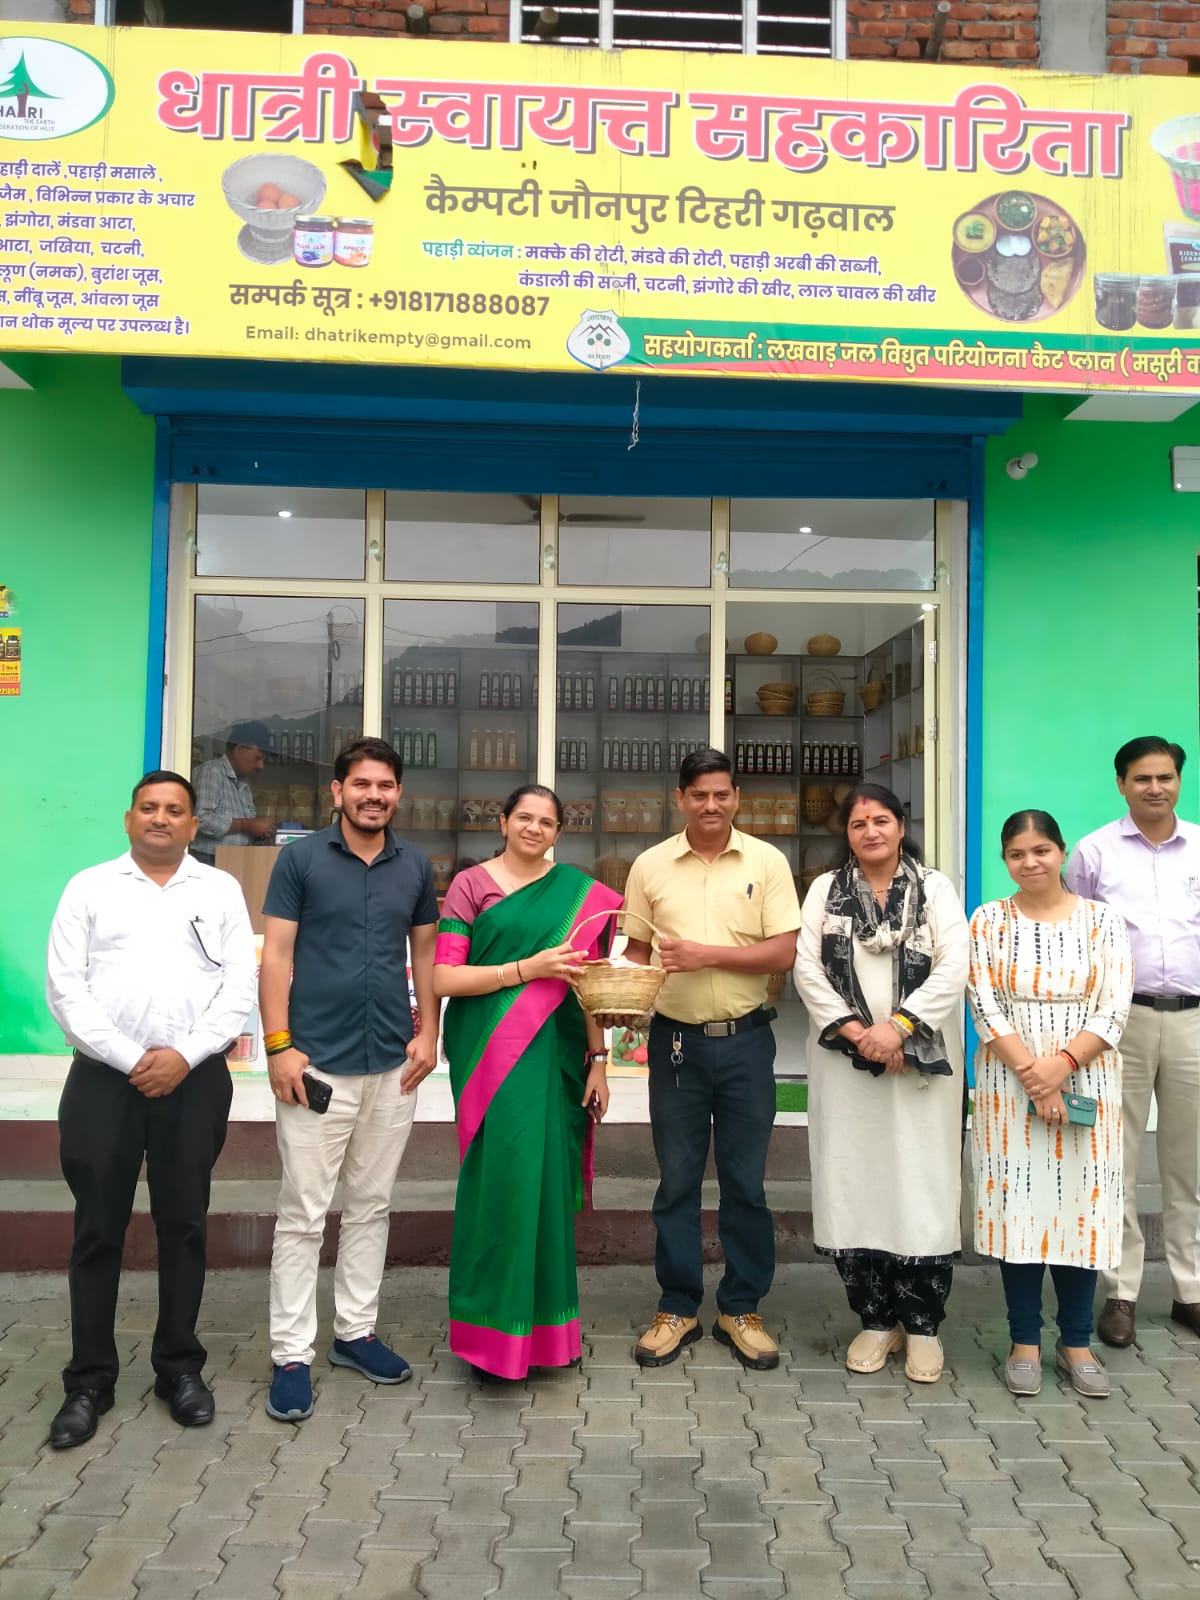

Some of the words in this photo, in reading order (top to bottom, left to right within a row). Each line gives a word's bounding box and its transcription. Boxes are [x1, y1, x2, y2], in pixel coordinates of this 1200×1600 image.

[157, 52, 364, 143] धात्री
[374, 78, 680, 157] स्वायत्त
[688, 84, 1132, 179] सहकारिता
[36, 185, 92, 203] विभिन्न
[95, 192, 135, 205] प्रकार
[137, 189, 153, 205] के
[157, 193, 195, 207] अचार
[423, 173, 543, 218] कैम्पटी
[549, 178, 669, 234] जौनपुर
[675, 185, 766, 229] टिहरी
[771, 199, 896, 239] गढ़वाल
[5, 210, 54, 229] झंगोरा,
[57, 212, 96, 229] मंडवा
[99, 217, 136, 233] आटा,
[39, 236, 94, 257] जखिया,
[100, 239, 145, 258] चटनी,
[422, 239, 464, 260] पहाड़ी
[525, 243, 567, 260] मक्के
[570, 243, 592, 261] की
[594, 245, 628, 265] रोटी,
[631, 247, 667, 264] मंडवे
[669, 247, 690, 266] की
[692, 249, 727, 269] रोटी,
[730, 251, 771, 272] पहाड़ी
[774, 253, 812, 271] अरबी
[815, 254, 836, 272] की
[839, 256, 882, 276] सब्जी,
[90, 264, 130, 285] बुरांश
[132, 269, 163, 287] जूस,
[519, 270, 570, 288] कंडाली
[573, 271, 595, 289] की
[644, 274, 690, 295] चटनी,
[692, 277, 735, 295] झंगोरे
[737, 277, 759, 296] की
[762, 279, 795, 299] खीर,
[798, 285, 833, 299] लाल
[837, 286, 880, 301] चावल
[883, 284, 904, 302] की
[907, 285, 936, 303] खीर
[13, 286, 45, 309] नींबू
[46, 292, 77, 309] जूस,
[81, 289, 130, 307] आंवला
[132, 294, 160, 312] जूस
[229, 279, 307, 307] सम्पर्क
[369, 289, 550, 316] +918171888087
[22, 313, 55, 329] थोक
[57, 317, 94, 335] मूल्य
[96, 318, 117, 331] पर
[118, 319, 172, 334] उपलब्ध
[246, 325, 299, 341] Email:
[304, 328, 531, 350] dhatrikempty@gmail.com
[766, 338, 837, 369] लखवाड़
[840, 343, 879, 364] जल
[880, 337, 931, 374] विद्युत
[934, 339, 1028, 370] परियोजना
[1030, 341, 1064, 370] कैट
[1066, 350, 1117, 373] प्लान
